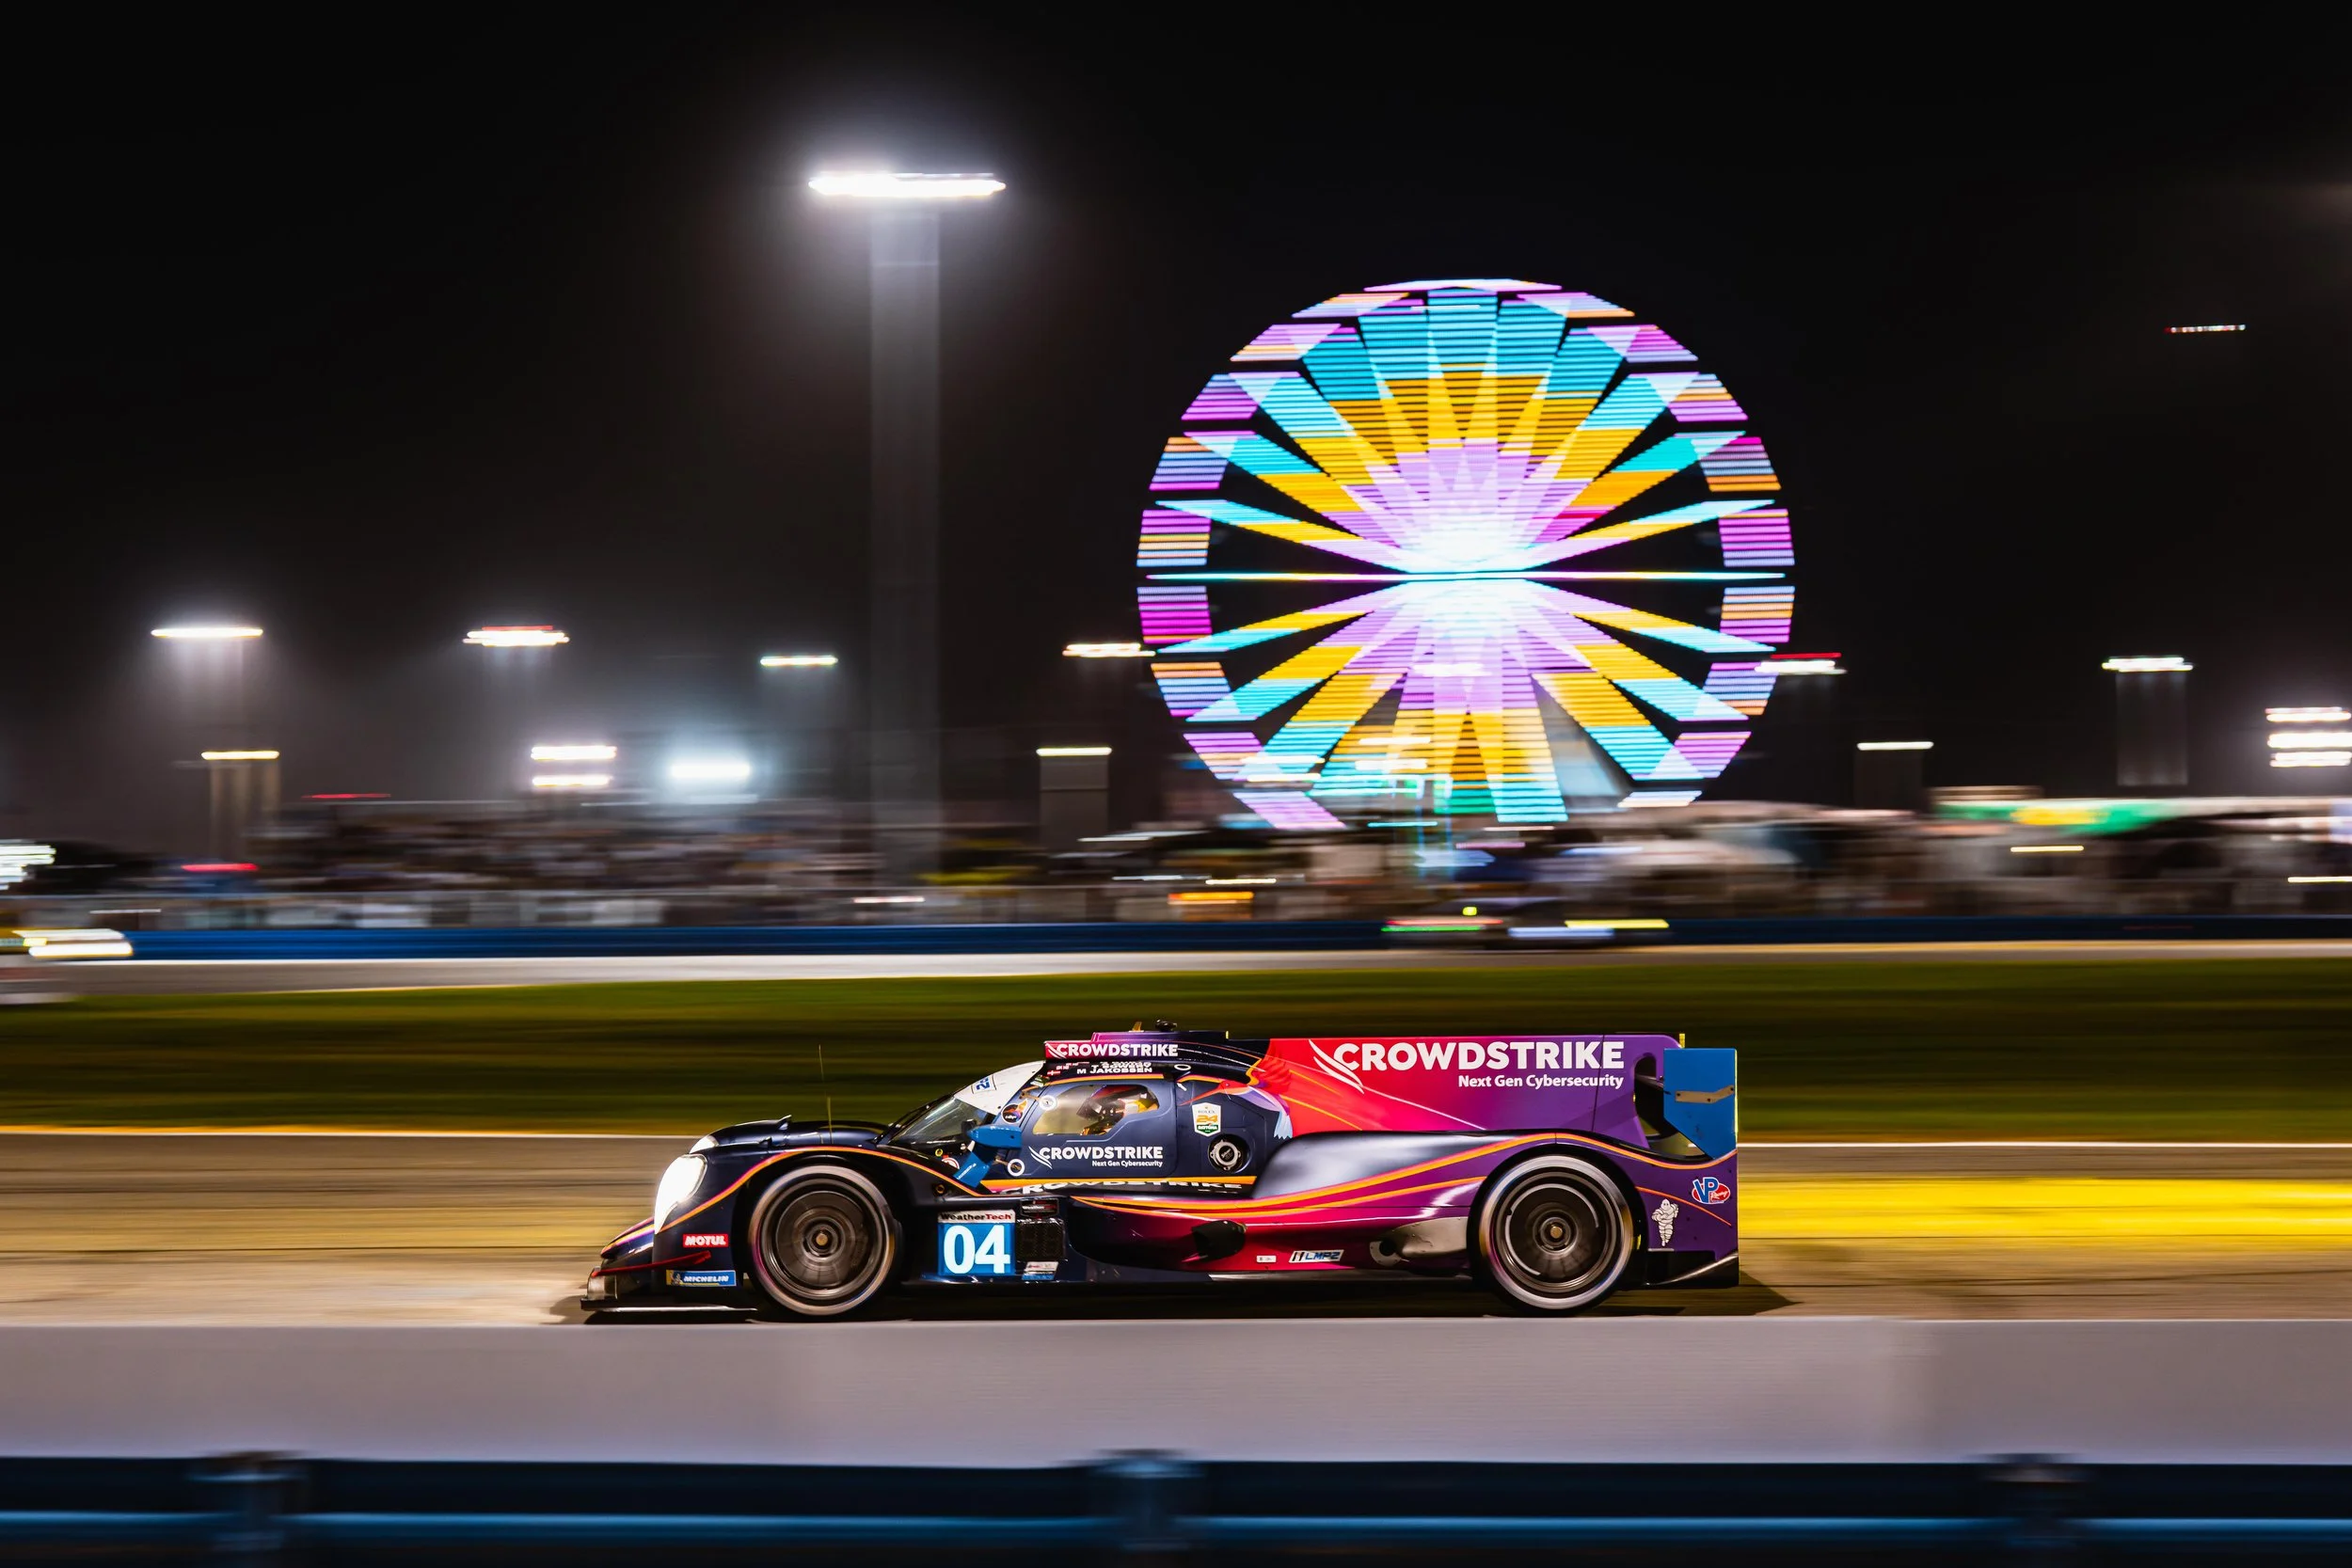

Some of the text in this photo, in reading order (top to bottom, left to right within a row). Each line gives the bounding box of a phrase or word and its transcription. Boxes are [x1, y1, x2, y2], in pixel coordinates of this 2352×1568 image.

[1056, 1043, 1178, 1057] CROWDSTRIKE
[1333, 1041, 1625, 1070] CROWDSTRIKE
[1458, 1075, 1624, 1090] Next Gen Cybersecurity
[1196, 1115, 1218, 1123] 24
[1039, 1146, 1163, 1160] CROWDSTRIKE
[1120, 1160, 1163, 1168] Cybersecurity
[1692, 1177, 1719, 1204] VP
[941, 1212, 1012, 1221] WeatherTech
[684, 1235, 726, 1246] MOTUL
[944, 1224, 1010, 1274] 04
[1305, 1251, 1341, 1260] LMP2
